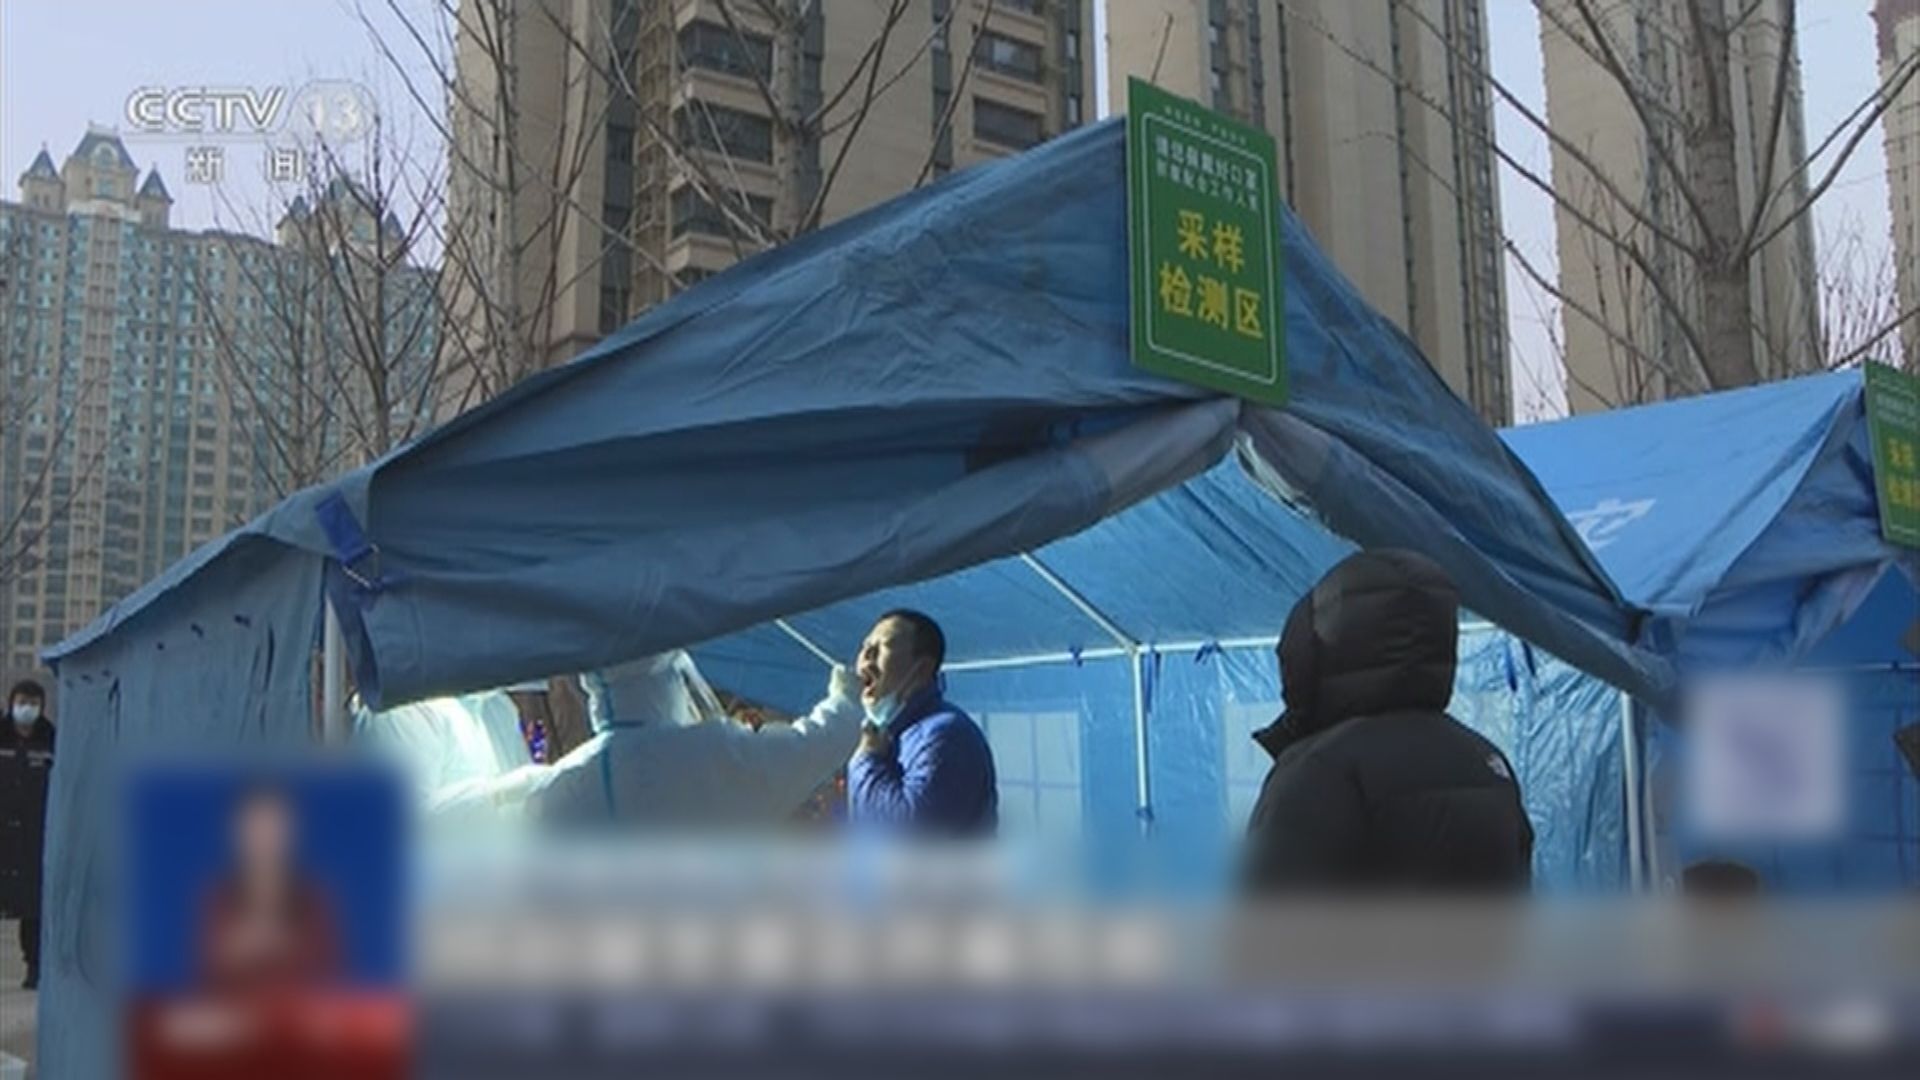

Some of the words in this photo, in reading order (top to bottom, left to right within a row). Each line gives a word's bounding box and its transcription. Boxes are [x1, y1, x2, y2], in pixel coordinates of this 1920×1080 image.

[1177, 210, 1245, 273] 采样
[1158, 262, 1263, 338] 检测区
